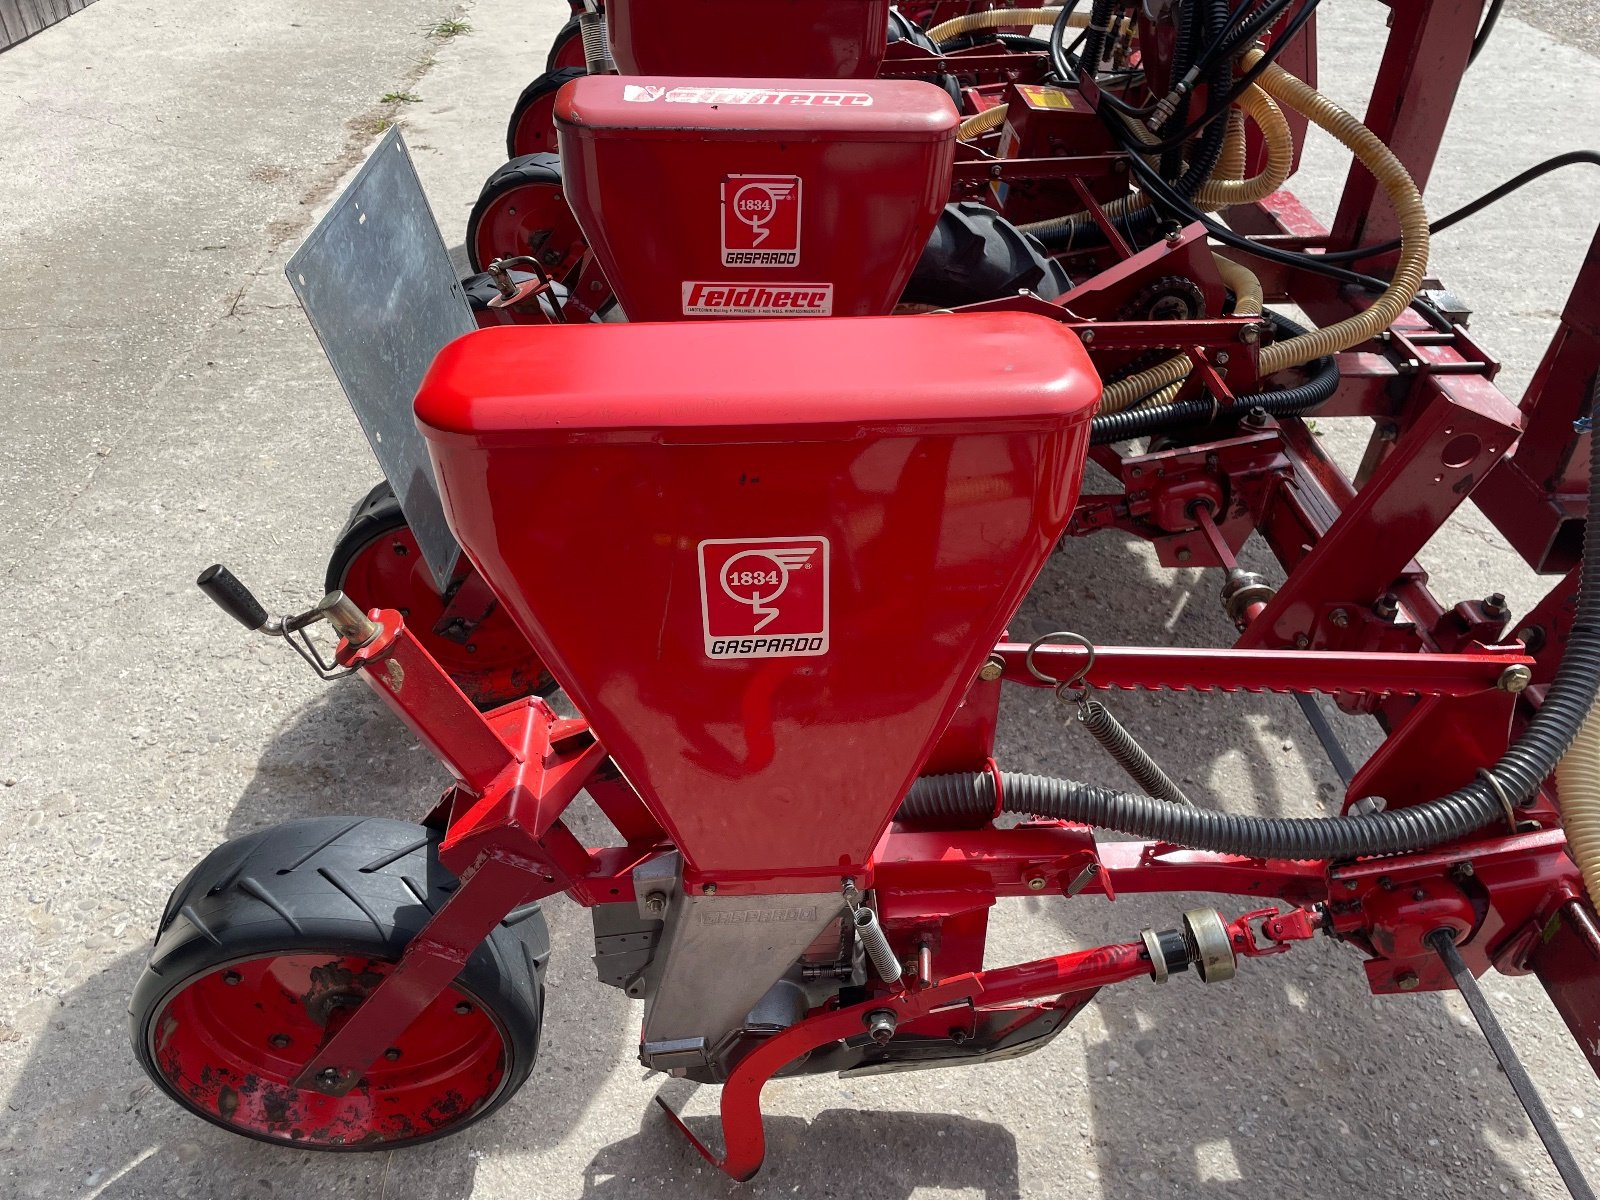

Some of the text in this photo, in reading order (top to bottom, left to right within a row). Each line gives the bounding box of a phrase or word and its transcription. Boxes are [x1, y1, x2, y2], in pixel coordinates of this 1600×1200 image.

[739, 199, 771, 211] 1834
[725, 252, 797, 265] GASPARDO
[729, 570, 779, 586] 1834
[711, 637, 824, 655] GASPARDO
[703, 907, 816, 925] GASPARDO
